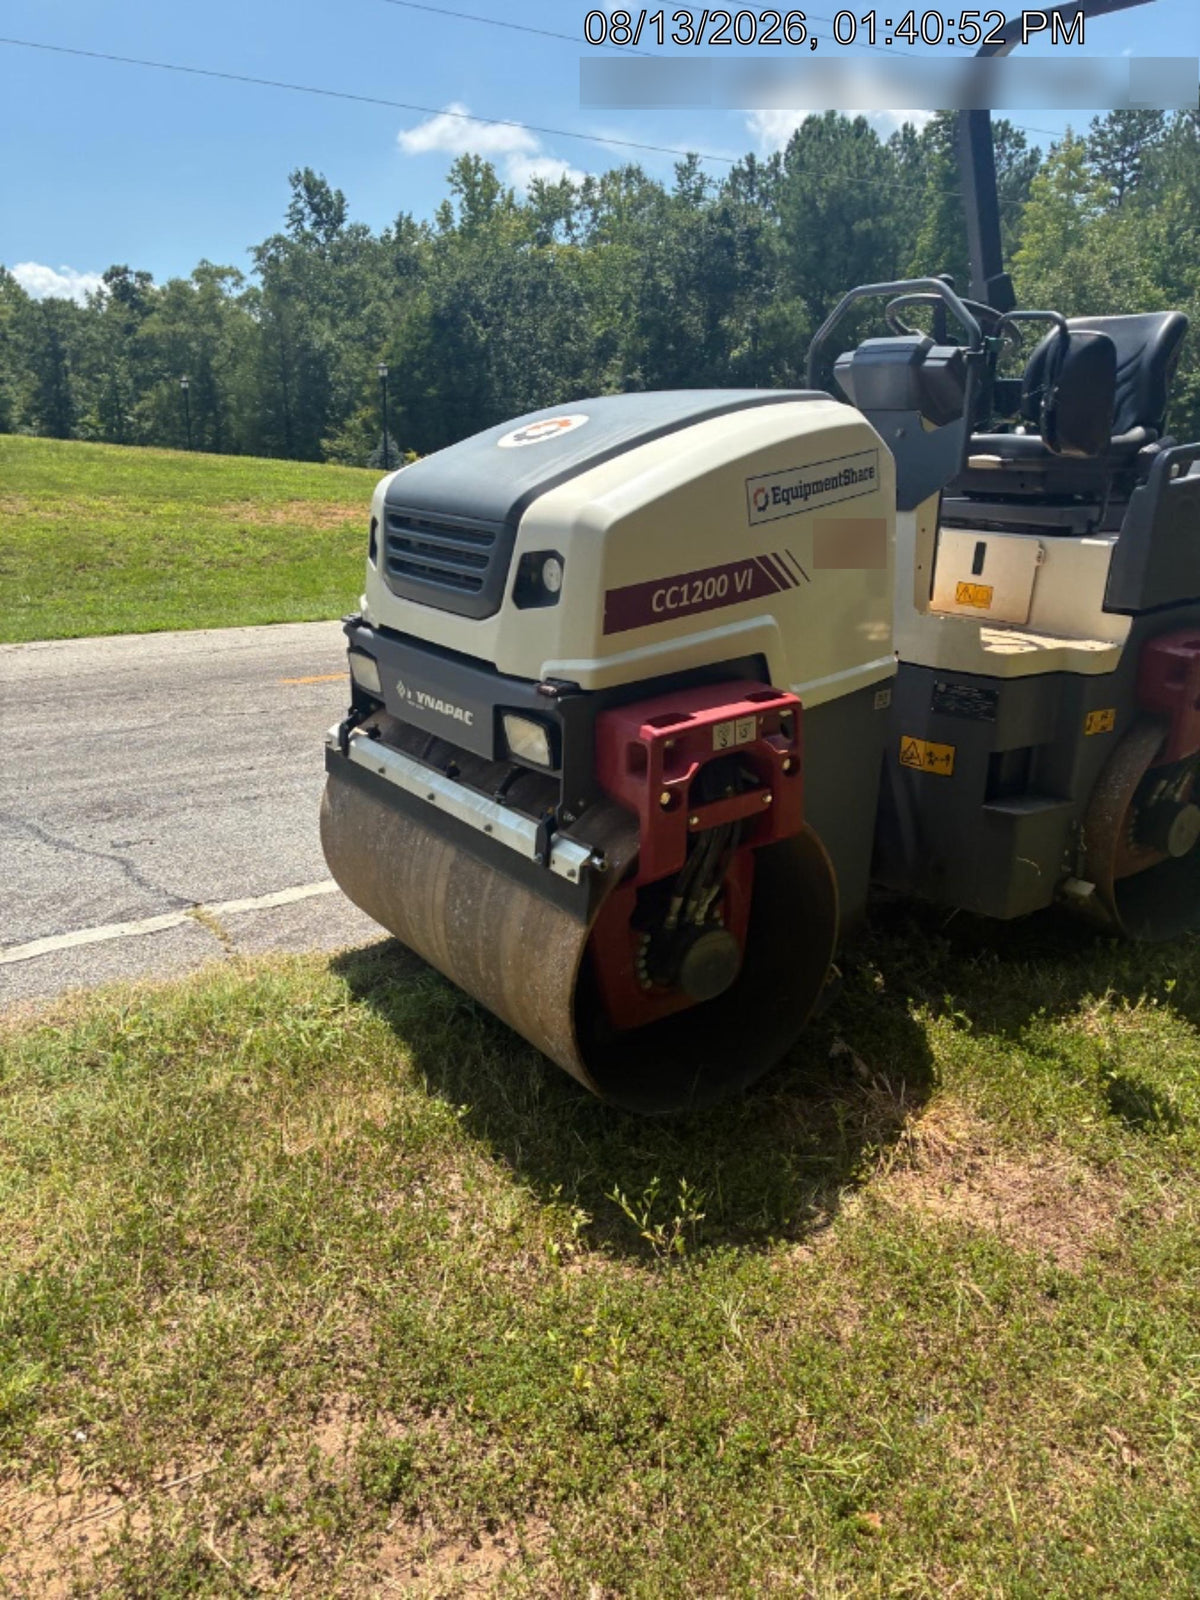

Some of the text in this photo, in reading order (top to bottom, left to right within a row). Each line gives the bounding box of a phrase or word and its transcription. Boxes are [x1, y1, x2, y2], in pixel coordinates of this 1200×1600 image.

[771, 466, 875, 505] EquipmentShare
[652, 569, 753, 612] CC1200 VI
